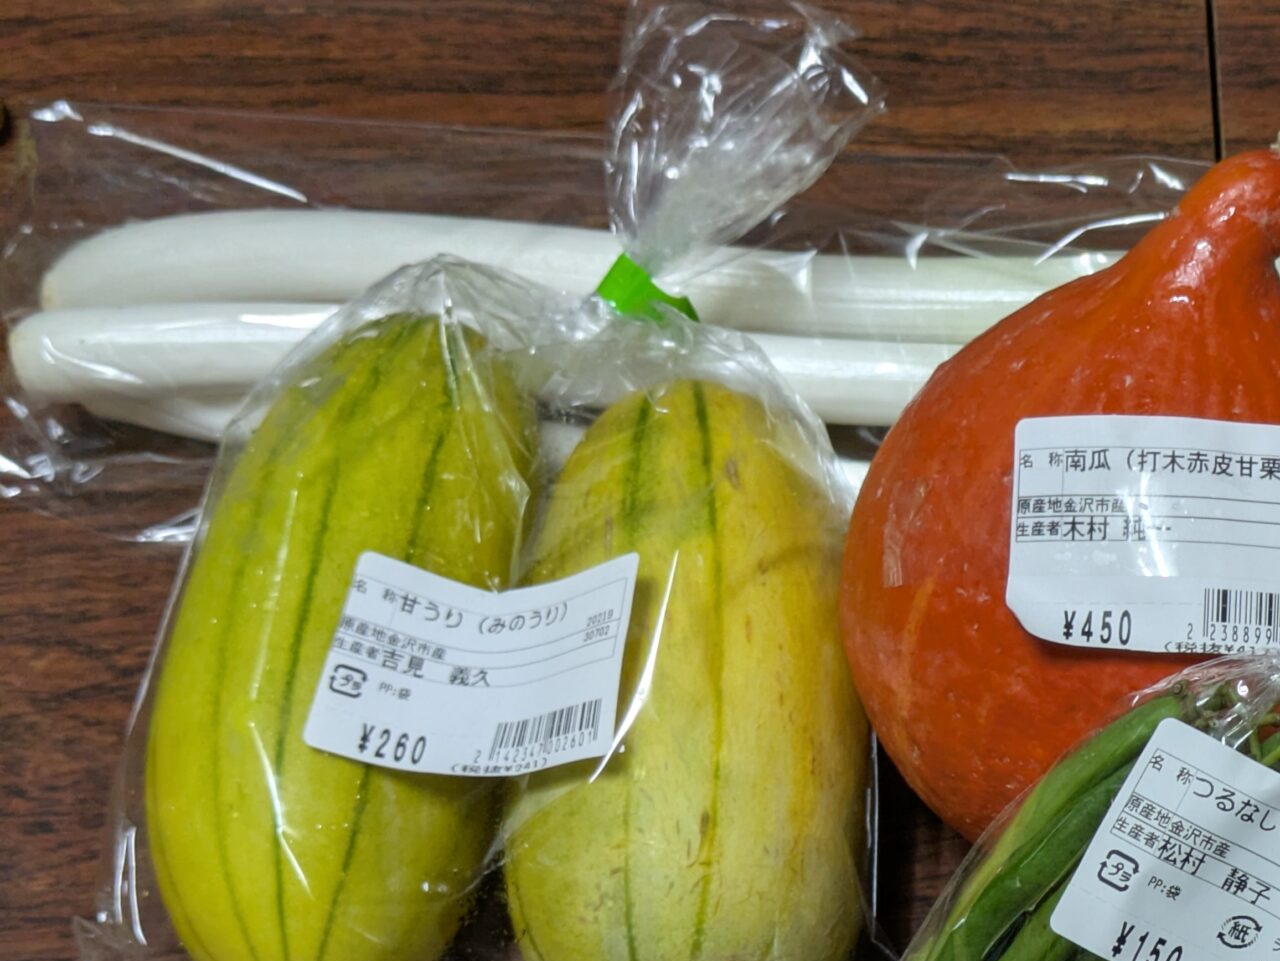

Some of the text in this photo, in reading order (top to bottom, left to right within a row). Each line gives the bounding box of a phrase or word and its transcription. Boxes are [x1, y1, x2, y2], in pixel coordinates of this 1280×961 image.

[1017, 497, 1062, 514] 原産地
[1016, 521, 1061, 536] 生産者
[1062, 517, 1109, 541] 木村
[1062, 609, 1132, 646] ¥450
[381, 650, 425, 679] 吉見
[449, 666, 491, 687] 義久
[358, 723, 427, 765] ¥260
[1123, 796, 1231, 859] 原産地 金沢市産
[1114, 816, 1271, 906] 生産者 松村 静子
